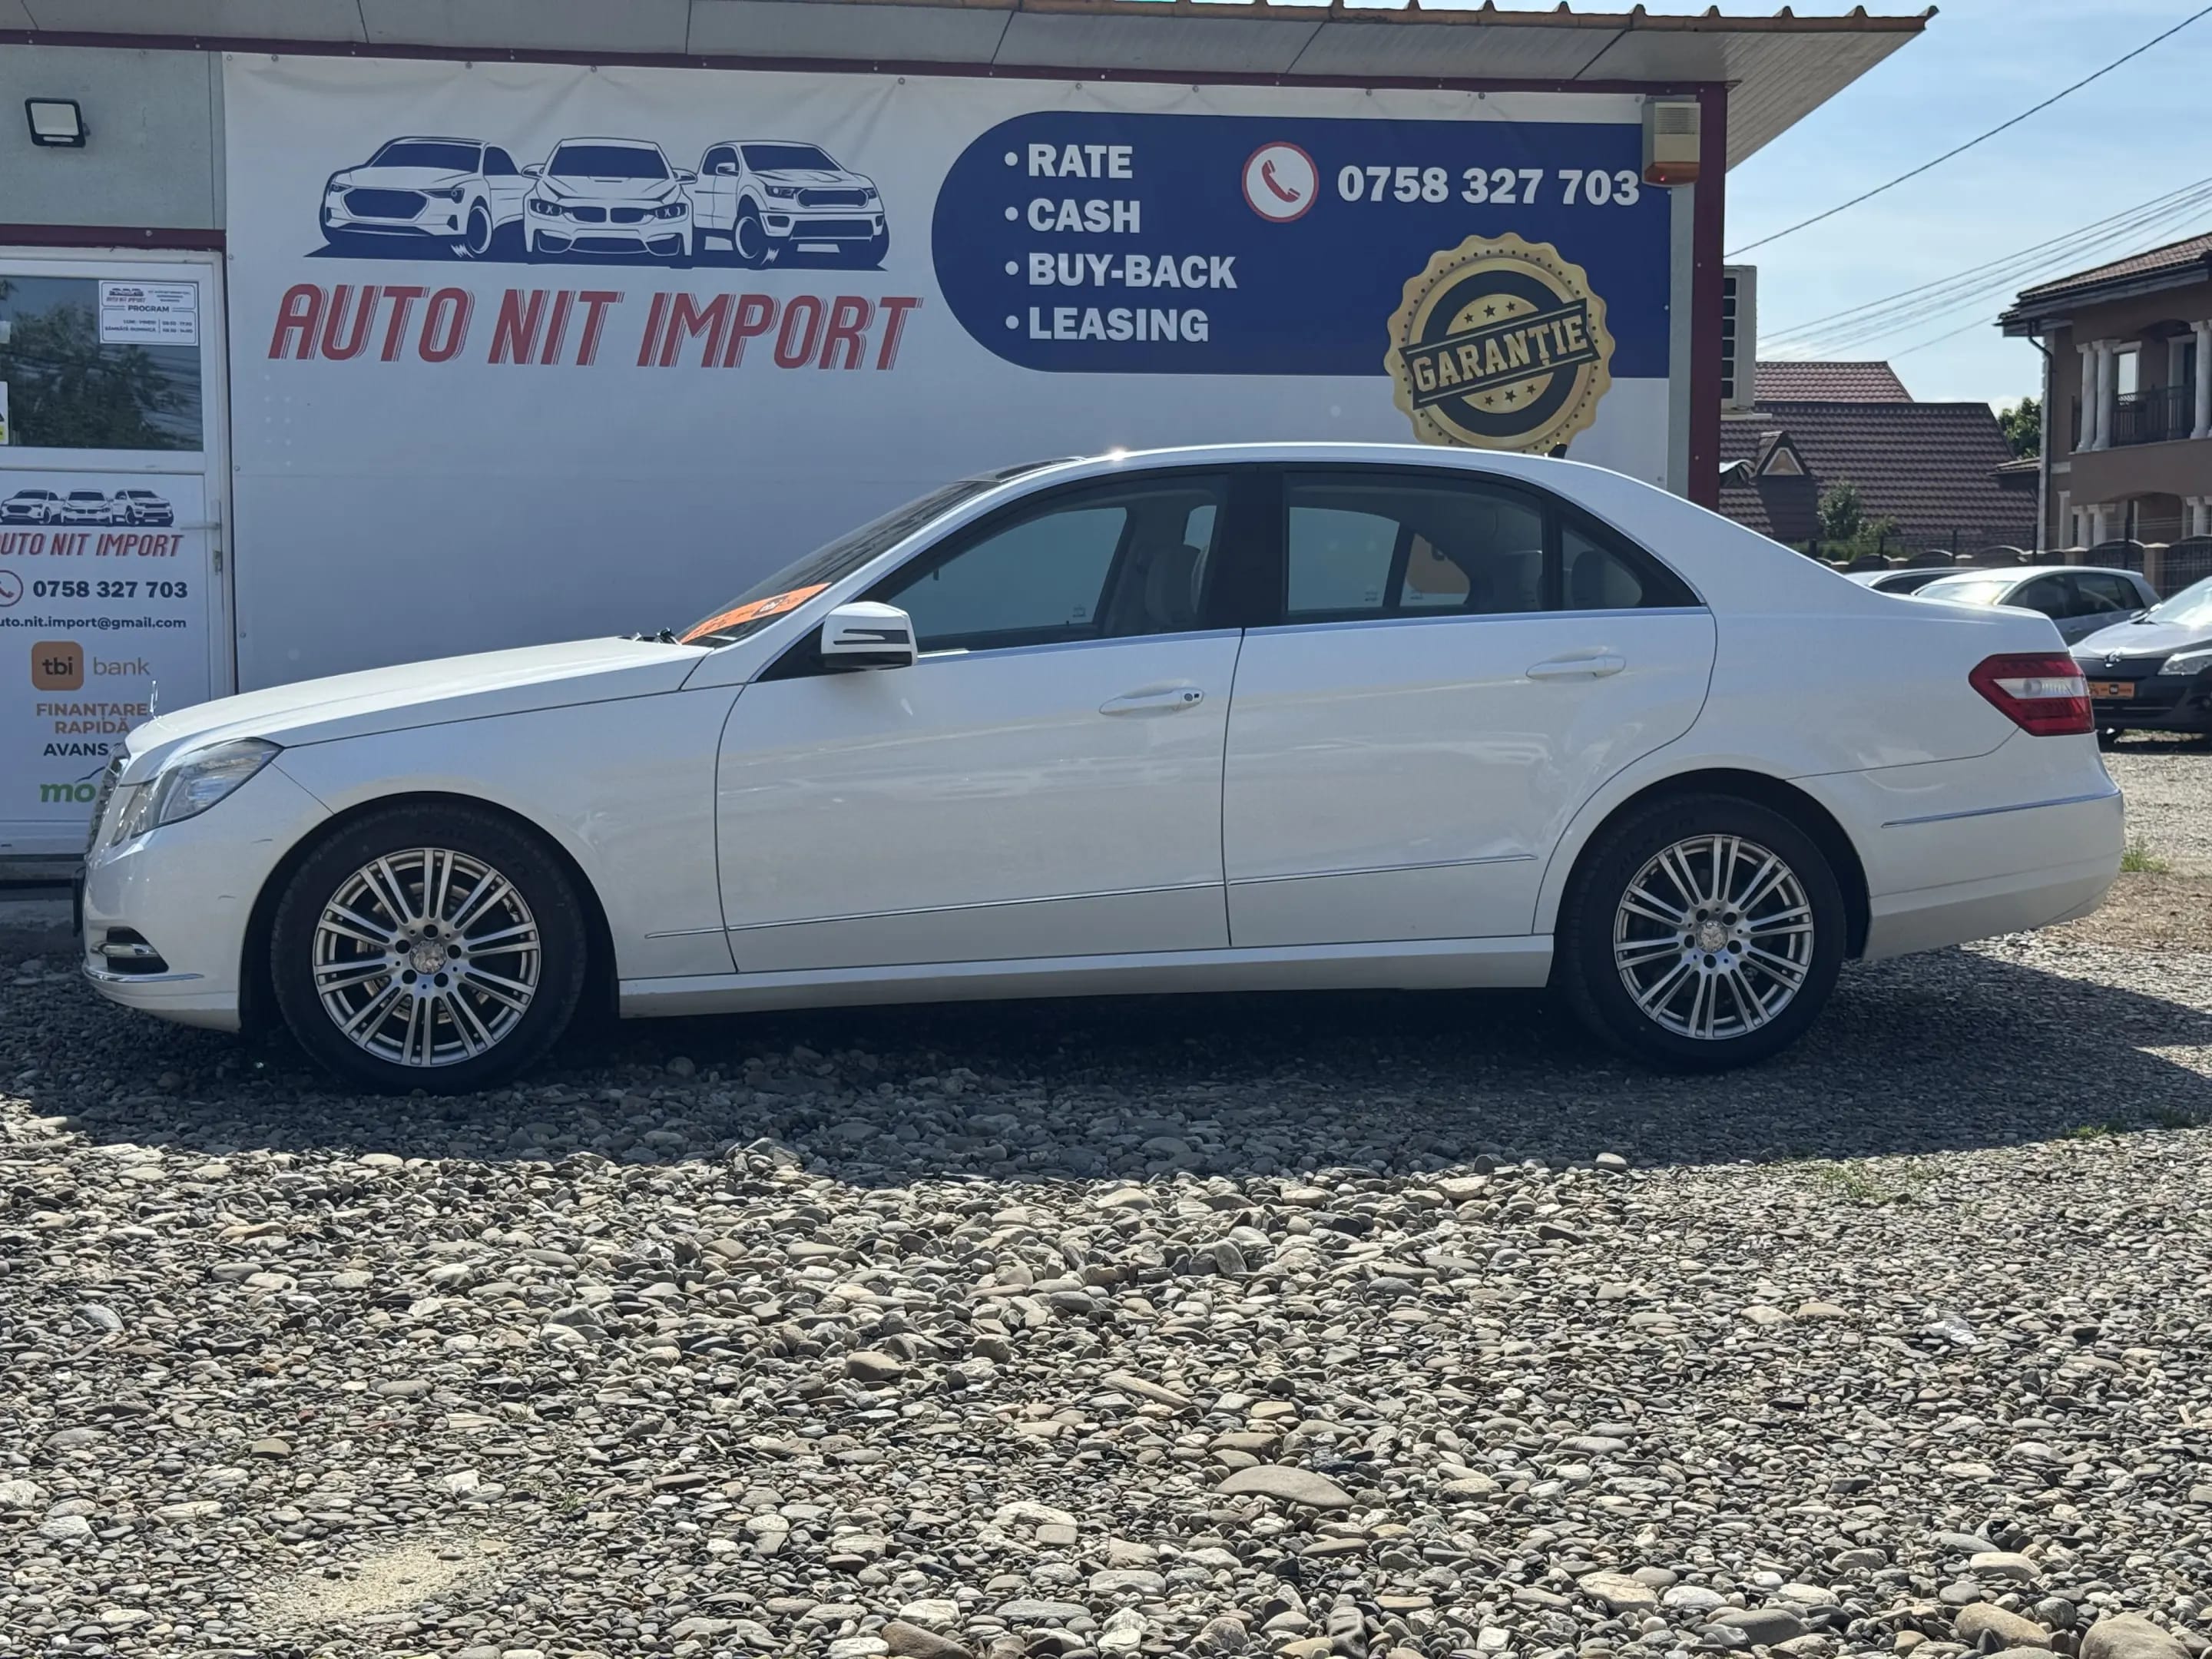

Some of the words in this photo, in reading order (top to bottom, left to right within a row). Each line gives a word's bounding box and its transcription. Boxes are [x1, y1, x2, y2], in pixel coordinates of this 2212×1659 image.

[1028, 144, 1133, 179] RATE
[1338, 166, 1449, 204] 0758
[1461, 167, 1544, 204] 327
[1558, 169, 1640, 206] 703
[1028, 198, 1141, 233] CASH
[1028, 253, 1238, 289] BUY-BACK
[268, 283, 475, 363] AUTO
[488, 288, 624, 366] NIT
[637, 292, 924, 371] IMPORT
[1029, 307, 1209, 342] LEASING
[1411, 314, 1588, 393] GARANȚIE
[0, 532, 47, 555] UTO
[50, 533, 91, 556] NIT
[96, 534, 184, 557] IMPORT
[33, 581, 90, 598] 0758
[96, 581, 138, 598] 327
[146, 581, 188, 598] 703
[42, 657, 73, 675] tbi
[93, 657, 151, 676] bank
[55, 717, 131, 734] RAPIDĂ
[43, 743, 109, 757] AVANS
